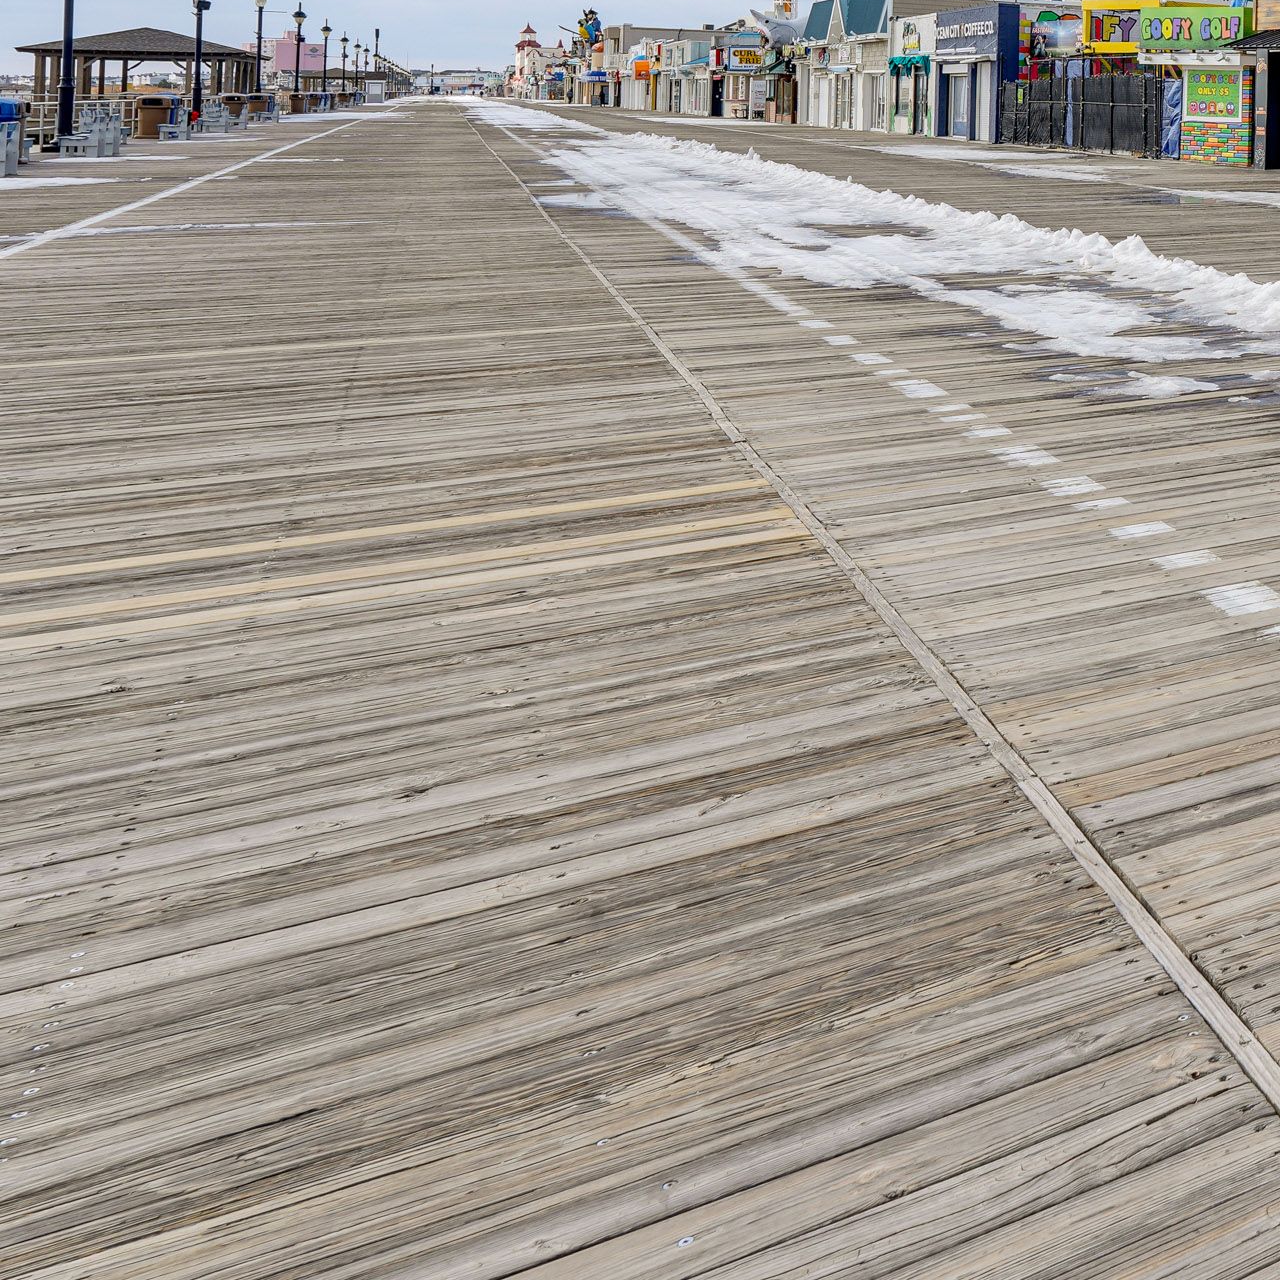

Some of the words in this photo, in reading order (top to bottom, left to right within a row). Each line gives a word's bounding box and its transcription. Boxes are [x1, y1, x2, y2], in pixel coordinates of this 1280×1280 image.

[935, 25, 951, 41] OCEAN
[950, 23, 961, 39] CITY
[964, 21, 985, 38] COFFEE
[985, 20, 994, 35] CO.
[1141, 17, 1192, 41] GOOFY
[1200, 16, 1240, 41] GOLF
[738, 57, 762, 65] FRIE
[1188, 73, 1217, 85] GOOFY
[1217, 73, 1239, 85] GOLF
[1197, 86, 1217, 96] ONLY
[1218, 86, 1230, 96] $5
